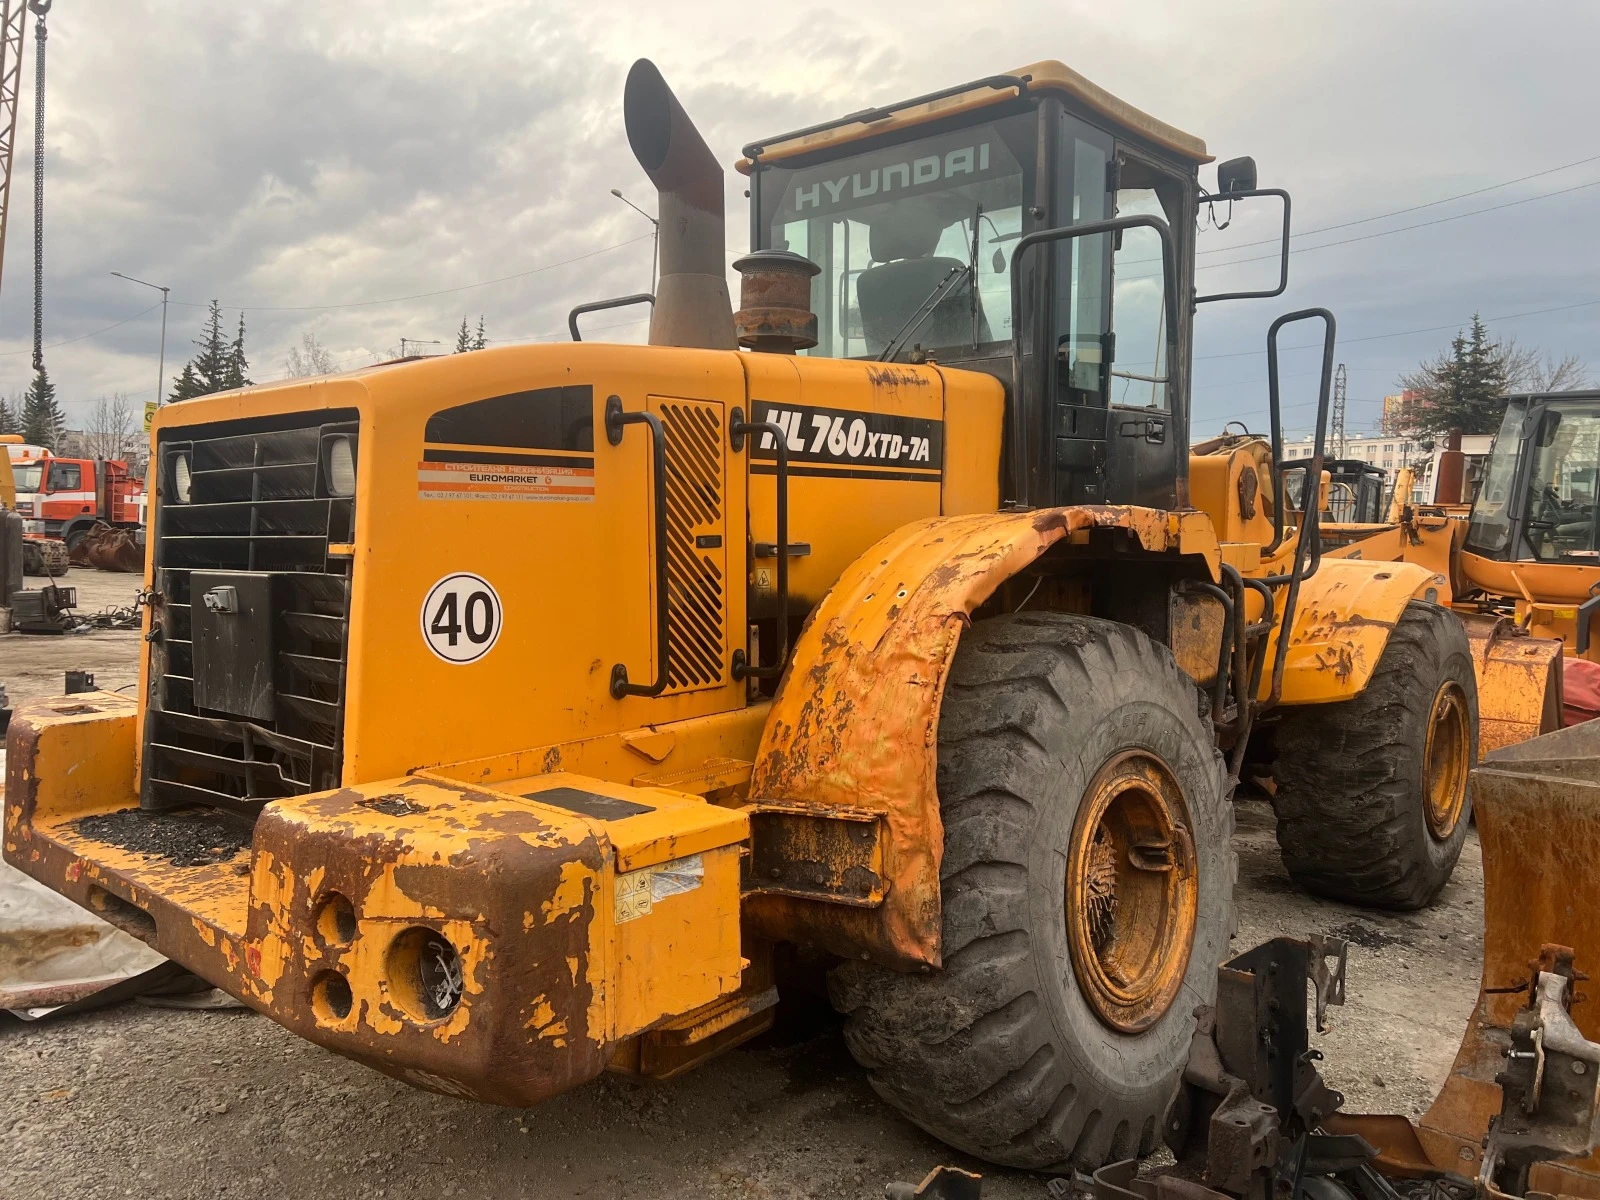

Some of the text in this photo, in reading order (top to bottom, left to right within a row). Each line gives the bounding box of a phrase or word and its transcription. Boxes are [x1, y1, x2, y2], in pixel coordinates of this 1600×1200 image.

[795, 142, 990, 211] HYUNDAI
[759, 409, 806, 452] HL
[444, 463, 506, 473] СТРОИТЕЛНА
[469, 473, 538, 484] EUROMARKET
[430, 590, 494, 647] 40
